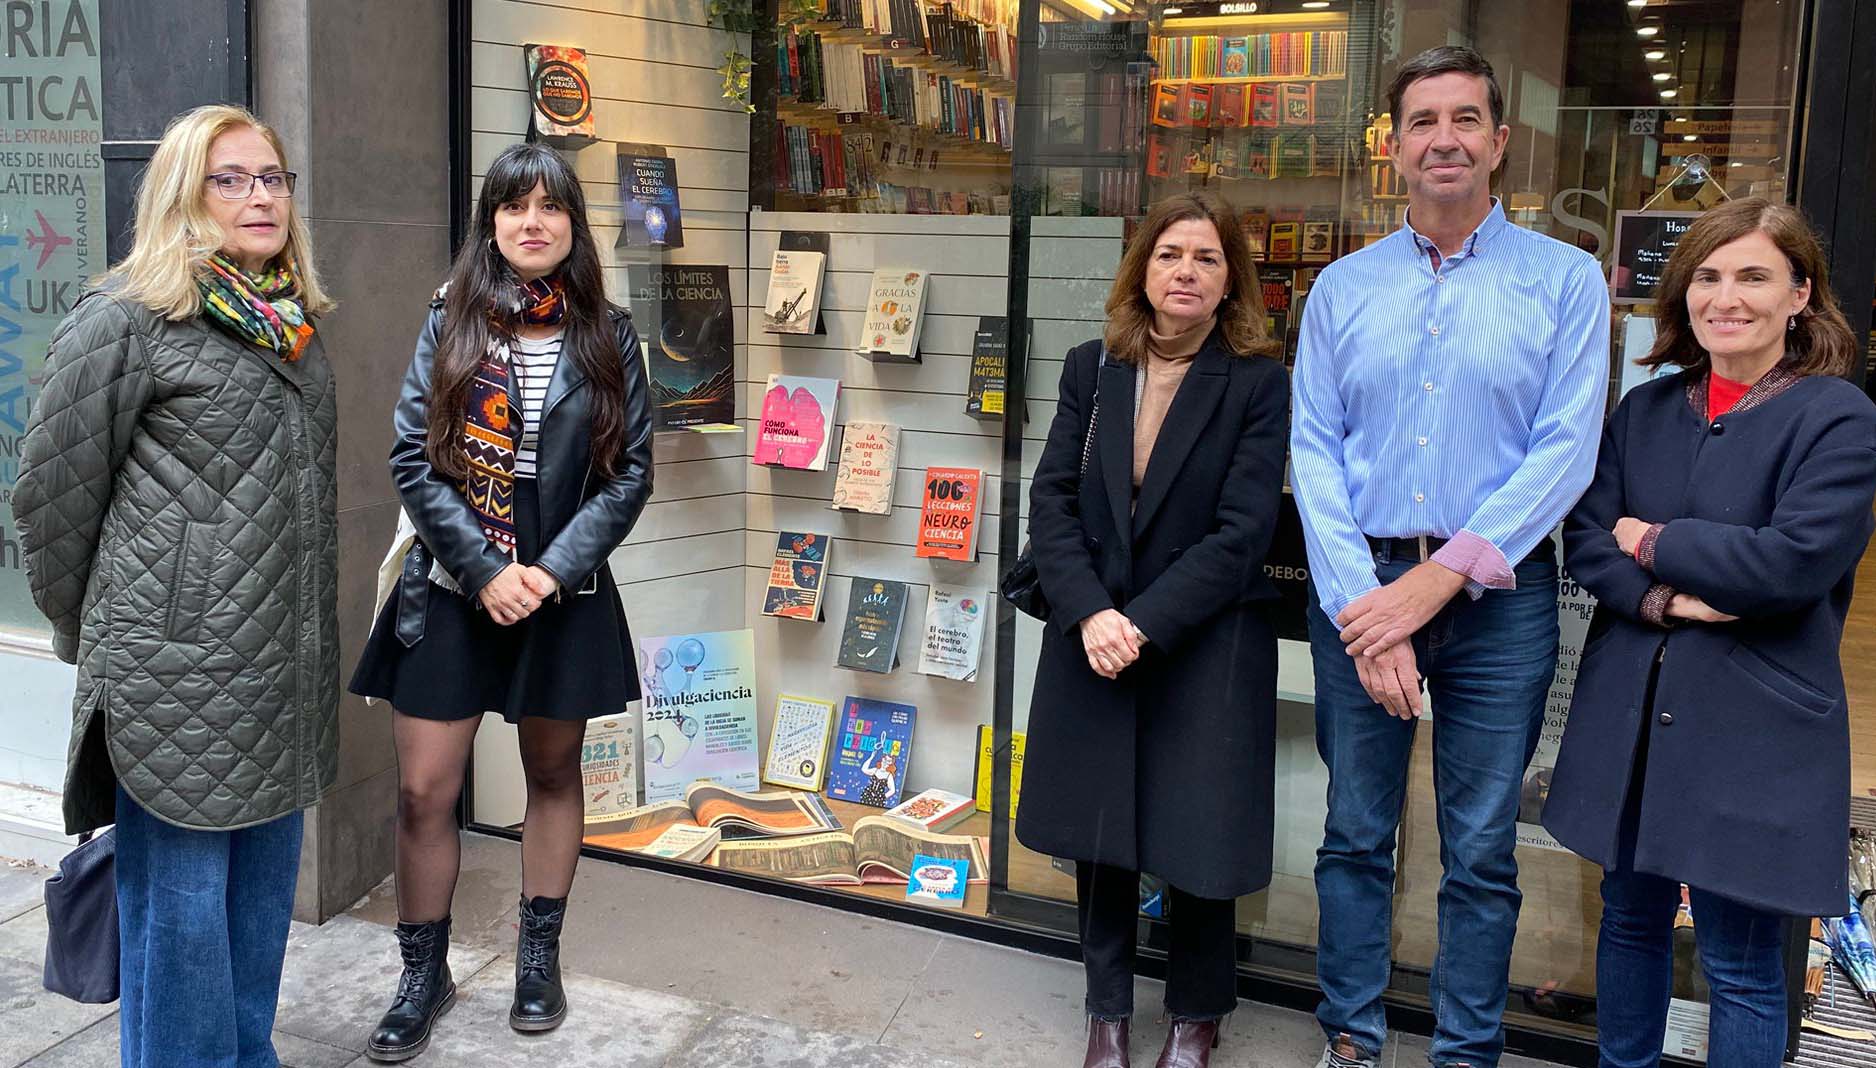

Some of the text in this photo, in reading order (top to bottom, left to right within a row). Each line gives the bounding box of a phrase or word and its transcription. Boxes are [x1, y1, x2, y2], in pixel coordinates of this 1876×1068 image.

[1220, 2, 1257, 14] BOLSILLO
[1060, 32, 1127, 41] Random House
[890, 40, 899, 49] G
[1060, 41, 1127, 51] Grupo Editorial
[554, 81, 577, 89] KRAUSS
[0, 75, 99, 121] TICA
[844, 114, 853, 123] B
[15, 129, 100, 148] EXTRANJERO
[26, 152, 45, 168] DE
[48, 149, 100, 169] INGLÉS
[636, 168, 665, 179] CUANDO
[640, 177, 664, 187] SUEÑA
[632, 185, 673, 196] EL CEREBRO
[76, 197, 89, 269] VERANO
[647, 269, 714, 285] LOS LÍMITES
[26, 279, 71, 315] UK
[640, 287, 725, 301] DE LA CIENCIA
[875, 288, 917, 298] GRACIAS
[872, 303, 913, 313] A LA
[869, 321, 891, 331] VIDA
[975, 356, 1006, 367] APOCALI
[764, 419, 786, 428] CÓMO
[763, 426, 800, 437] FUNCIONA
[865, 433, 876, 441] LA
[855, 441, 885, 450] CIENCIA
[863, 451, 873, 459] DE
[851, 467, 881, 477] POSIBLE
[927, 501, 972, 512] LECCIONES
[924, 514, 972, 530] NEURO
[924, 527, 965, 540] CIENCIA
[1263, 565, 1308, 581] DEBO
[1569, 602, 1586, 612] POR
[1580, 611, 1591, 620] DE
[930, 625, 969, 639] El cerebro,
[928, 633, 961, 646] el teatro
[928, 642, 968, 655] del mundo
[646, 686, 753, 708] Divulgaciencia
[1549, 703, 1569, 716] alg
[647, 709, 682, 722] 2024
